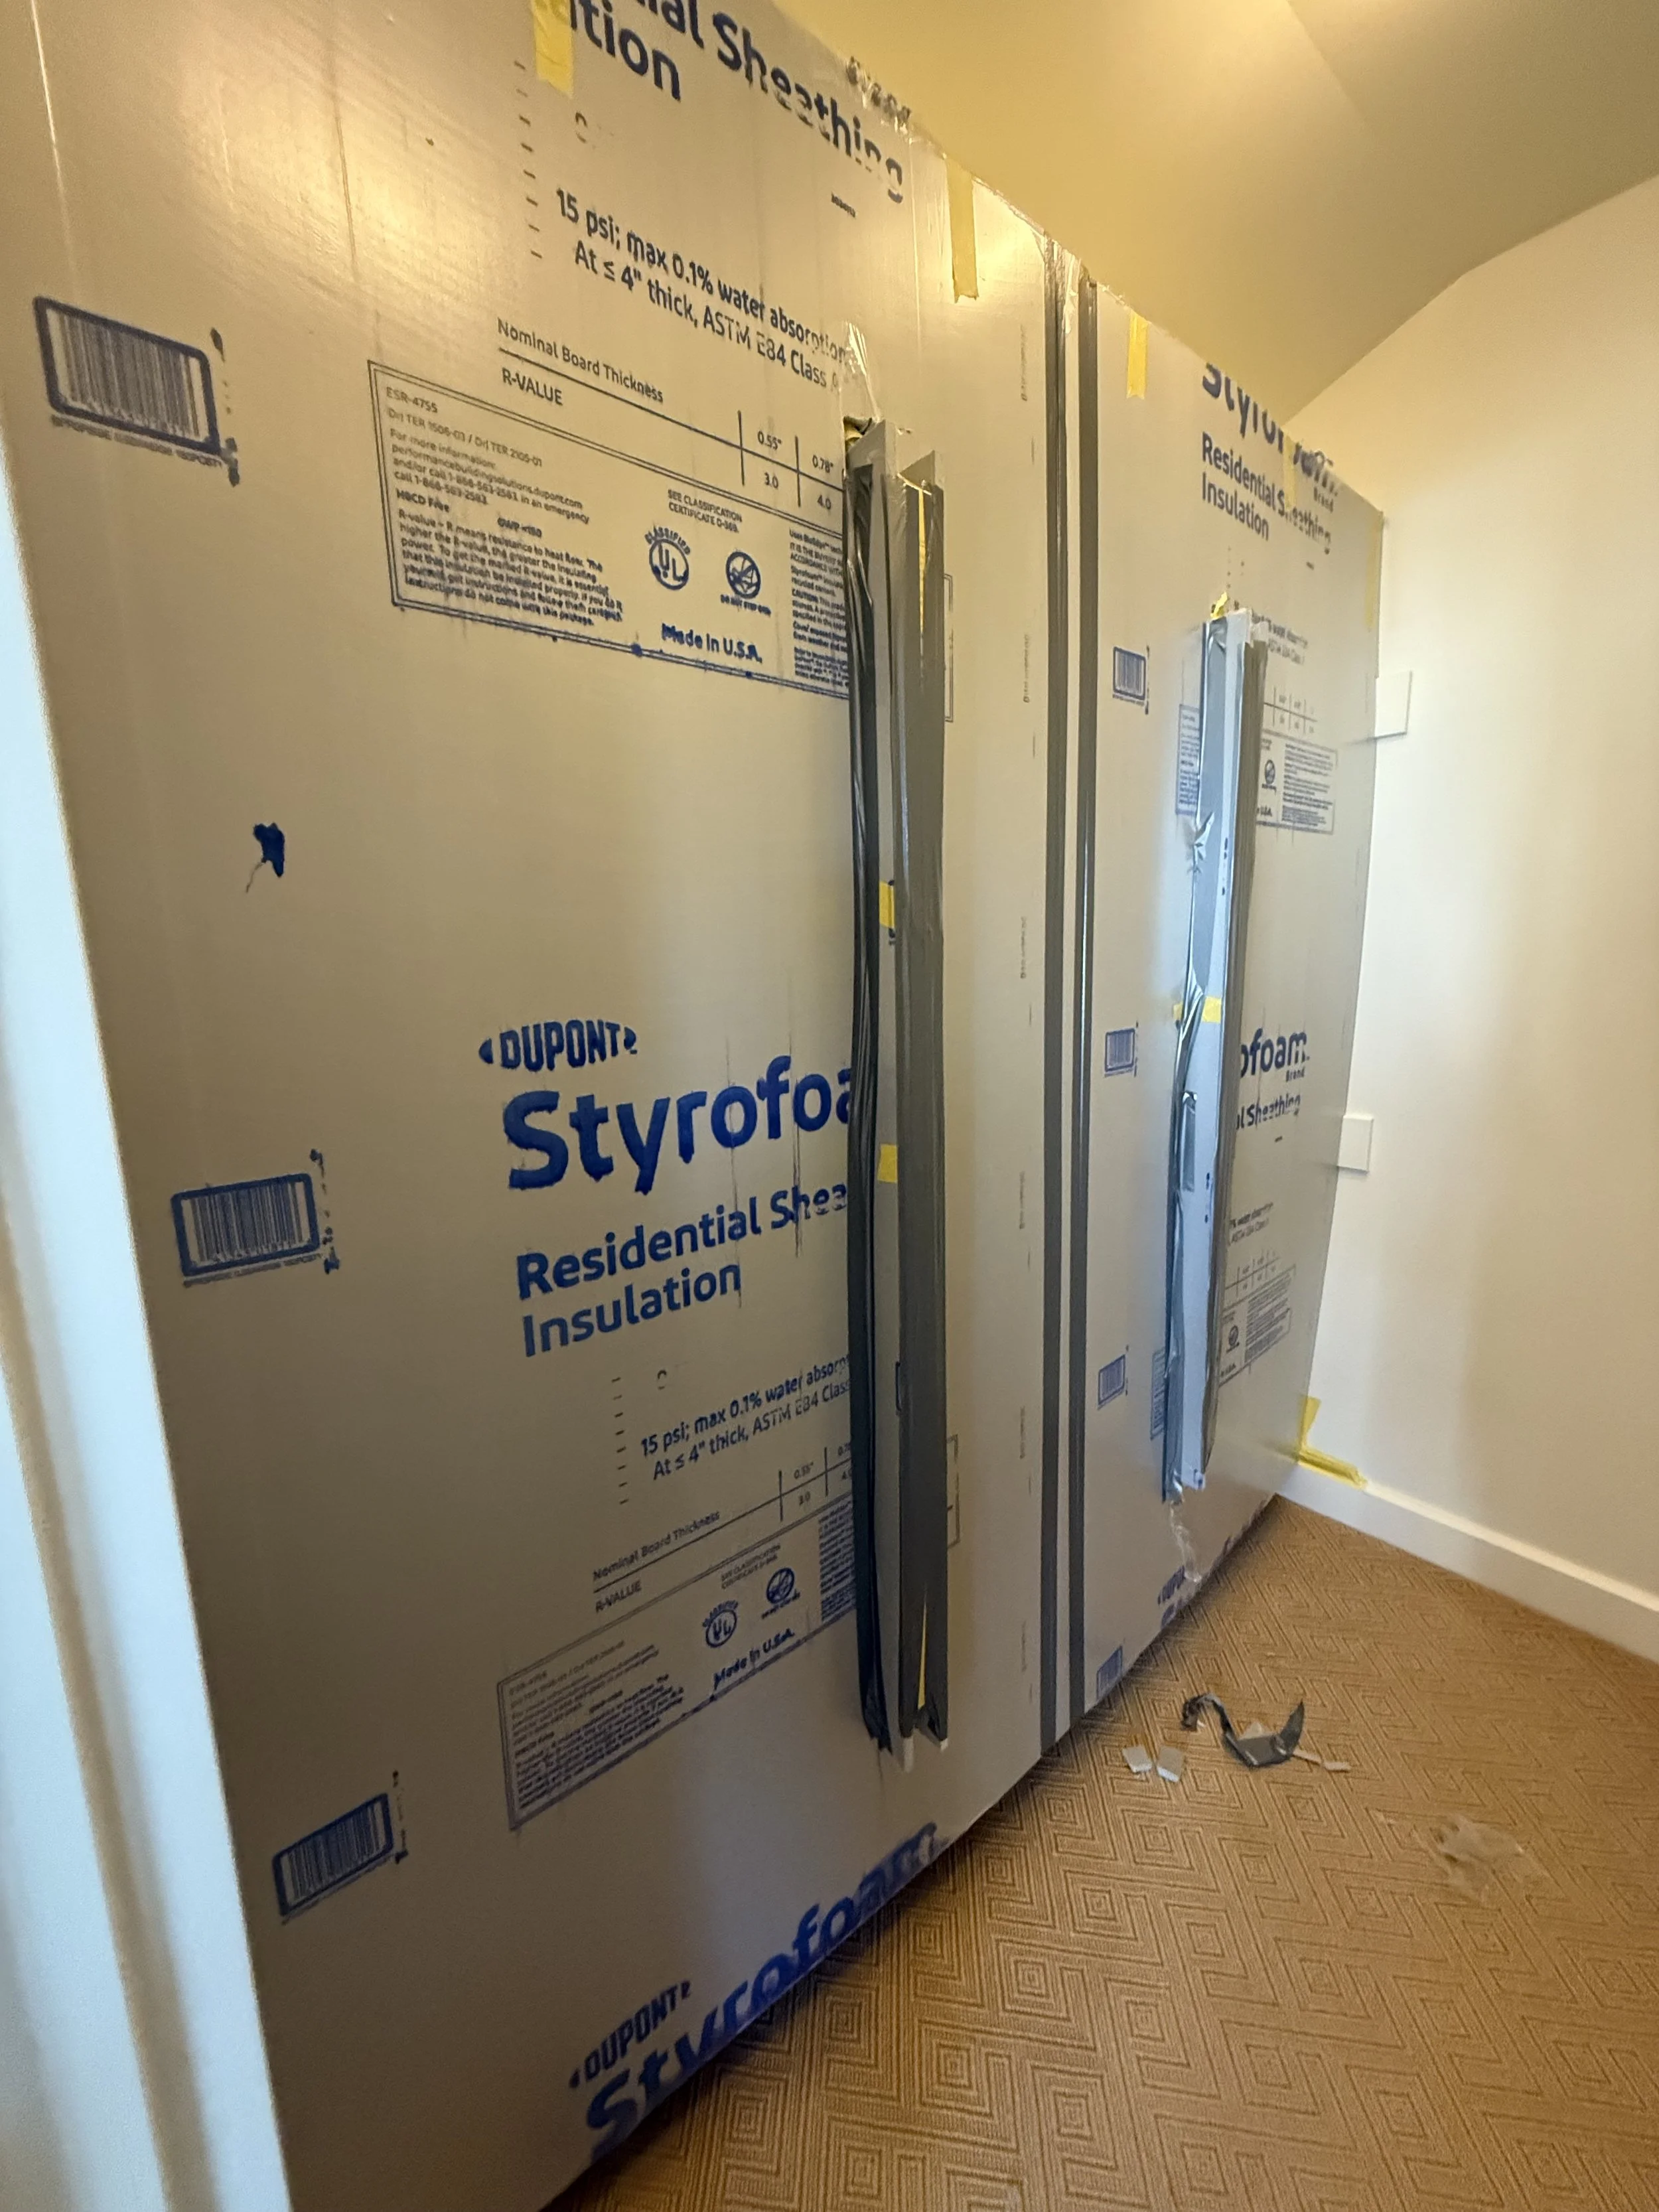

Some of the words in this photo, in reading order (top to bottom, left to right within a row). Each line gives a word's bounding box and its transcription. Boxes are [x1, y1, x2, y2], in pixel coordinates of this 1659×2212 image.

[556, 187, 579, 224] 15
[586, 210, 620, 250] psi;
[626, 230, 669, 275] max
[672, 253, 713, 295] 0.1%
[717, 277, 765, 324] water
[575, 240, 598, 275] At
[648, 278, 697, 328] thick,
[703, 305, 751, 350] ASTM
[756, 331, 786, 366] E84
[791, 350, 827, 388] Class
[498, 317, 559, 359] Nominal
[562, 344, 599, 377] Board
[603, 363, 663, 404] Thickness
[501, 366, 563, 406] R-VALUE
[394, 468, 412, 483] call
[764, 472, 779, 490] 3.0
[817, 494, 831, 510] 4.0
[1202, 431, 1277, 512] Residential
[543, 502, 589, 526] emergency
[668, 488, 682, 502] SEE
[684, 494, 742, 523] CLASSIFICATION
[668, 501, 715, 525] CERTIFICATE
[1202, 471, 1269, 542] Insulation
[661, 623, 703, 650] Made
[723, 637, 763, 664] U.S.A.
[499, 1019, 621, 1072] DUPONT
[1285, 1066, 1305, 1082] Brand
[1246, 1094, 1301, 1127] Sheathing
[516, 1197, 762, 1301] Residential
[522, 1264, 742, 1358] Insulation
[640, 1434, 658, 1457] 15
[664, 1422, 689, 1452] psi;
[694, 1408, 726, 1434] max
[730, 1391, 762, 1419] 0.1%
[765, 1375, 804, 1404] water
[653, 1458, 671, 1481] At
[709, 1425, 749, 1455] thick,
[753, 1404, 791, 1436] ASTM
[795, 1392, 818, 1416] E84
[593, 1550, 638, 1582] Nominal
[642, 1533, 671, 1557] Board
[673, 1511, 720, 1540] Thickness
[595, 1580, 642, 1613] R-VALUE
[585, 1984, 679, 2083] DUPONT
